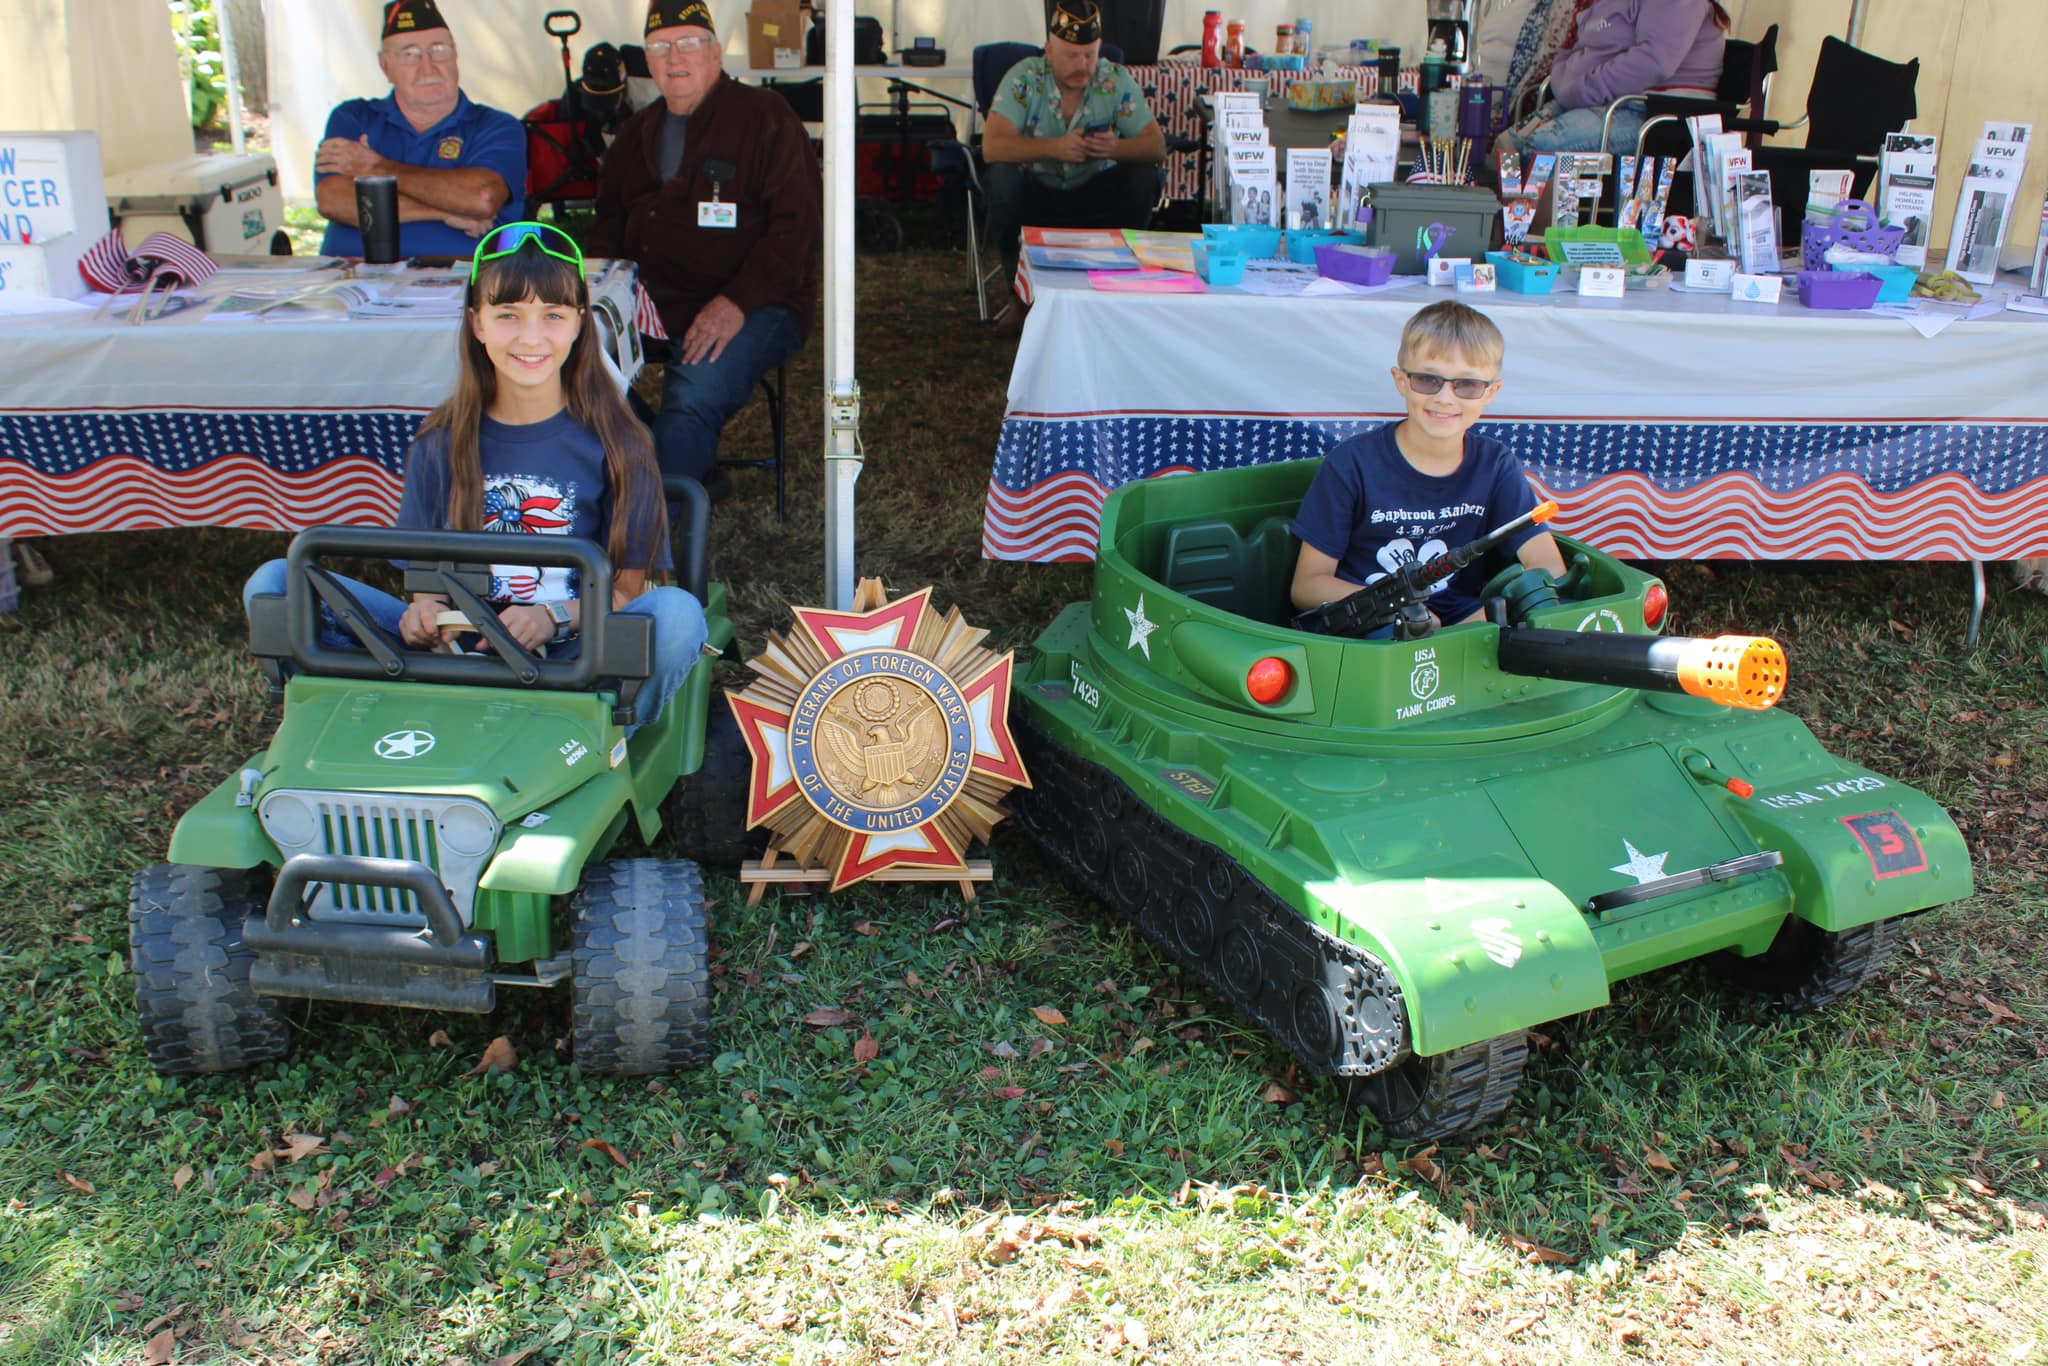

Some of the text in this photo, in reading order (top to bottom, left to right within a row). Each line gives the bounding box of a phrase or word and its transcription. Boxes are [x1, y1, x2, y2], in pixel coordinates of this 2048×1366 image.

[1232, 132, 1262, 142] VFW
[1234, 151, 1265, 161] VFW
[1728, 156, 1747, 167] VFW
[1986, 146, 2016, 157] VFW
[1371, 509, 1435, 524] Saybrook
[1414, 647, 1436, 662] USA
[794, 655, 966, 748] VETERANS OF FOREIGN WARS
[1072, 676, 1099, 709] 7429
[1396, 694, 1456, 720] TANK CORPS
[803, 750, 967, 829] OF THE UNITED STATES
[1169, 771, 1214, 796] STEP
[1760, 776, 1887, 809] USA 7429
[1868, 823, 1905, 856] 3
